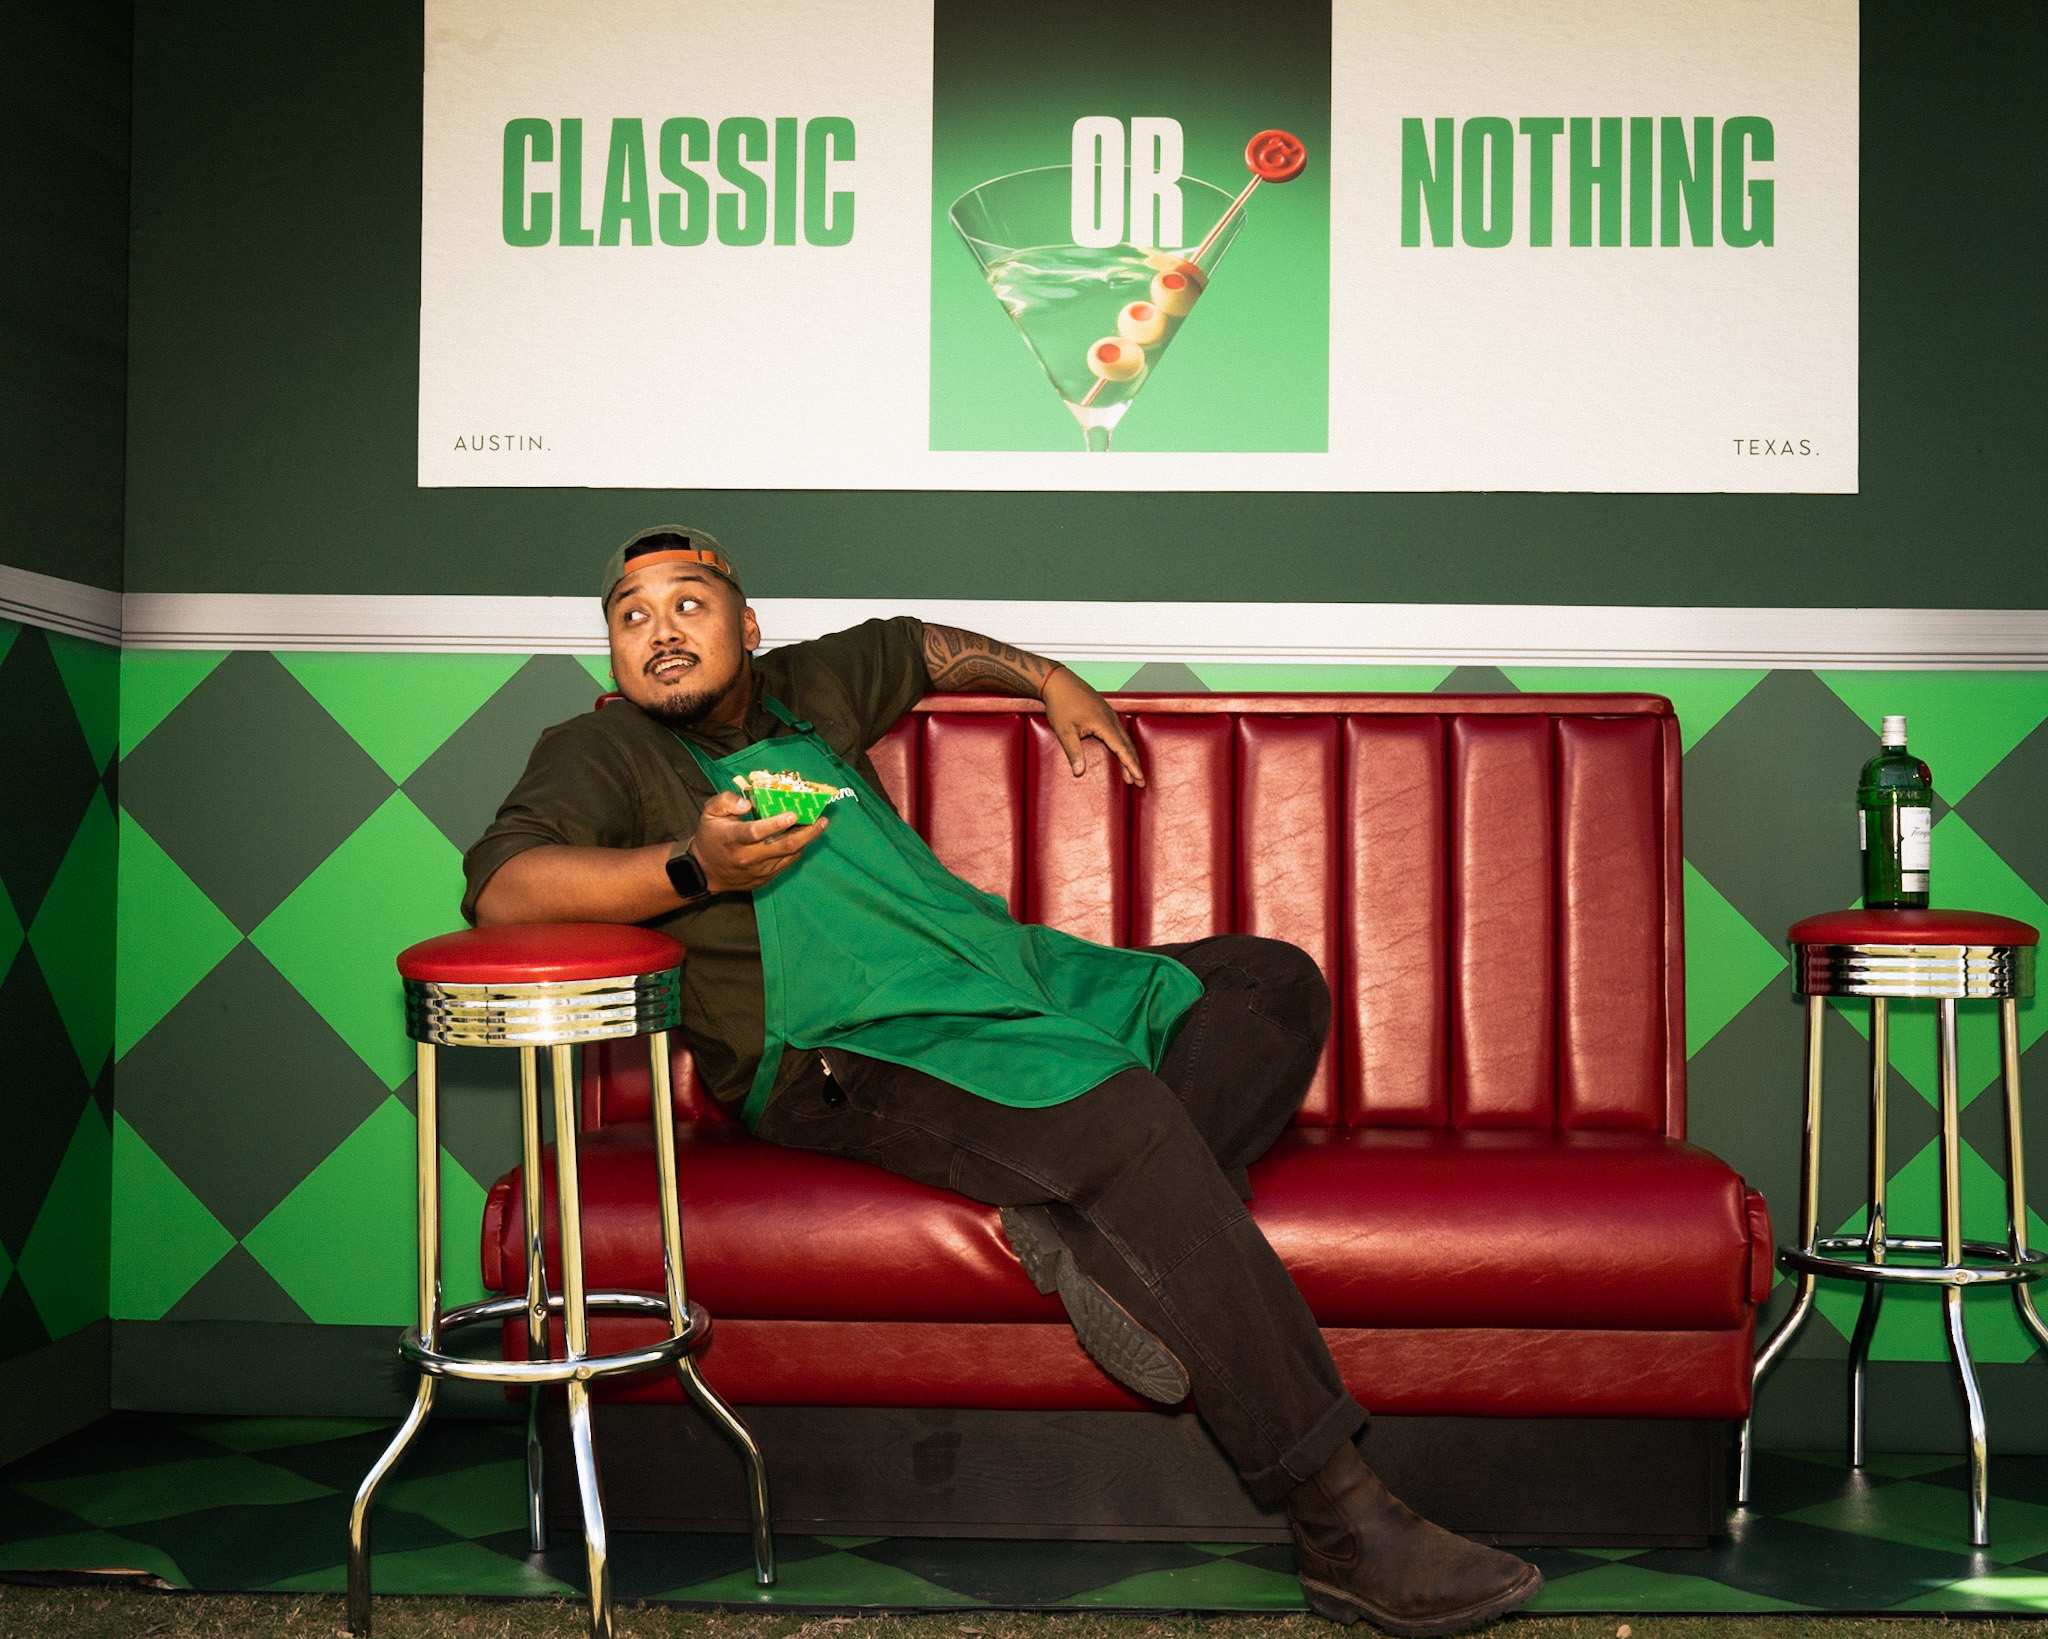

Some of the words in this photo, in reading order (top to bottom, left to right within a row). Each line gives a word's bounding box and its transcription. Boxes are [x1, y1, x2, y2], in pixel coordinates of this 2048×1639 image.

[503, 117, 856, 248] CLASSIC
[1070, 115, 1186, 249] OR
[1401, 116, 1775, 249] NOTHING
[454, 434, 551, 451] AUSTIN.
[1733, 439, 1819, 456] TEXAS.
